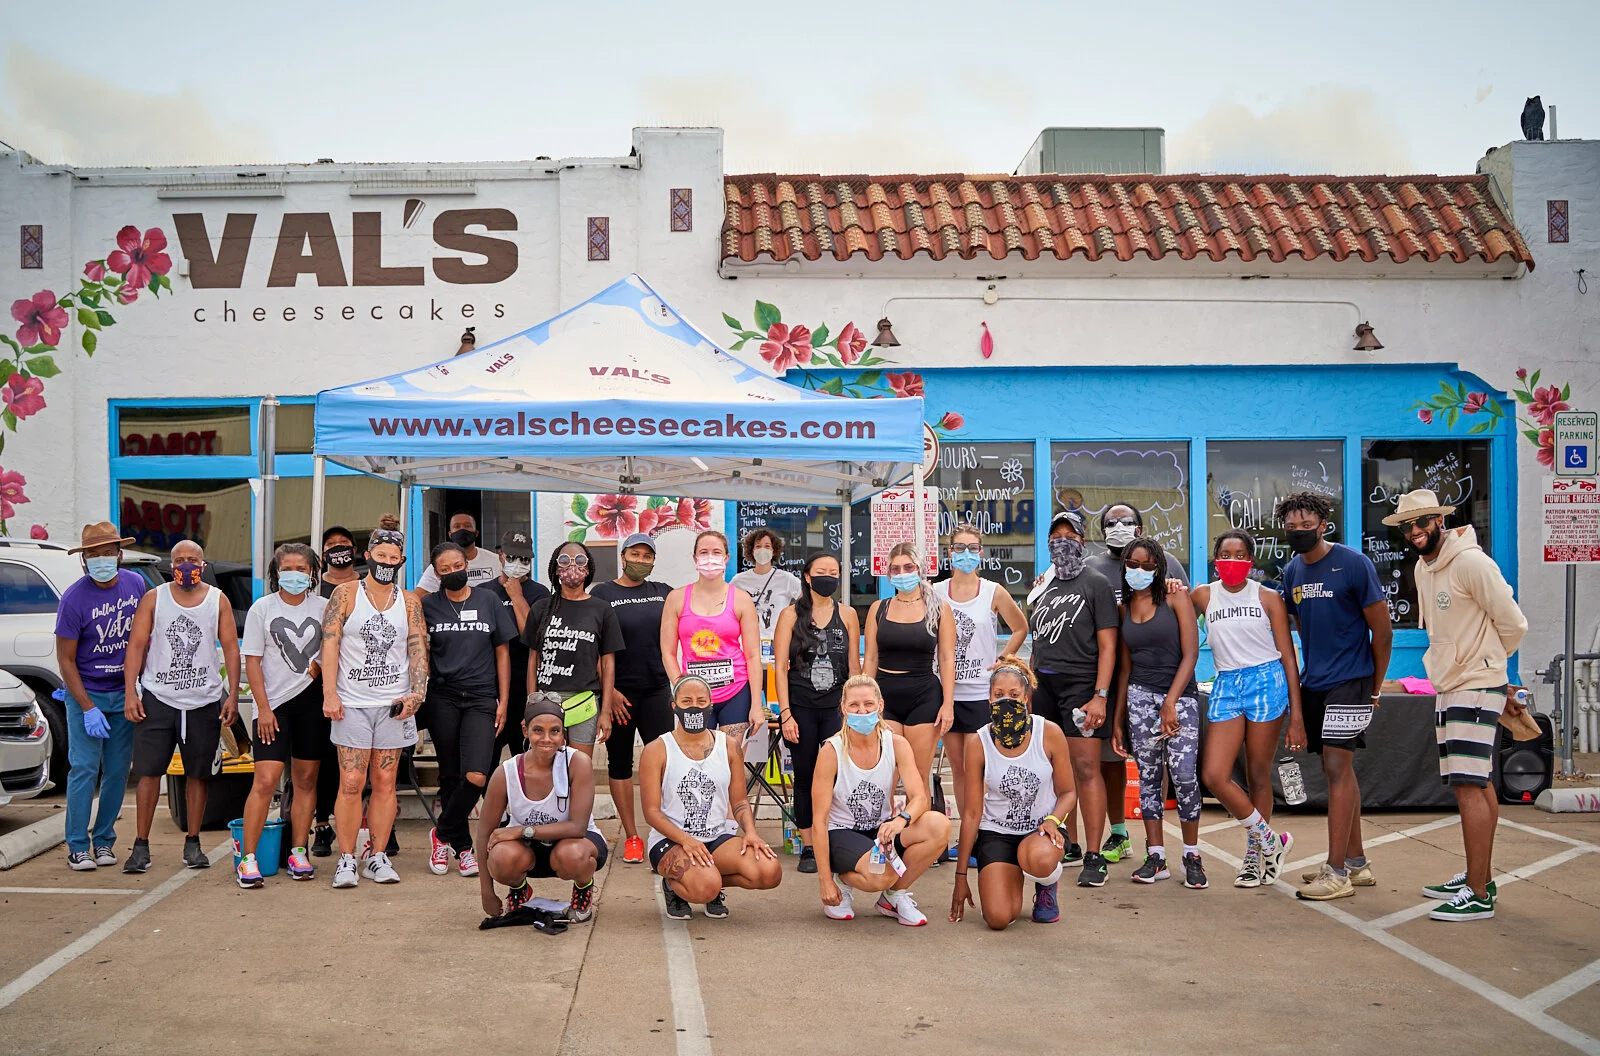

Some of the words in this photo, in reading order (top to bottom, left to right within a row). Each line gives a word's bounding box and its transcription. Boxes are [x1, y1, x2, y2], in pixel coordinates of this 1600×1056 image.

[172, 198, 519, 289] VAL'S
[194, 299, 505, 323] cheesecakes
[485, 352, 515, 375] VAL'S
[588, 366, 672, 385] VAL'S
[368, 411, 877, 440] www.valscheesecakes.com
[1557, 417, 1596, 426] RESERVED
[1559, 431, 1594, 440] PARKING
[938, 447, 978, 470] HOURS
[1424, 459, 1446, 478] HOME
[1545, 494, 1571, 503] TOWING
[1572, 494, 1600, 503] ENFORCE
[1229, 496, 1264, 530] CALL
[740, 517, 767, 527] Turtle
[977, 558, 1002, 571] IMES
[92, 602, 116, 619] Dallas
[117, 594, 139, 609] County
[610, 598, 632, 608] DALLAS
[1210, 607, 1262, 624] UNLIMITED
[429, 622, 491, 633] #REALTOR
[545, 625, 596, 643] lackness
[368, 673, 401, 688] JUSTICE
[955, 668, 981, 681] USTICE
[174, 676, 208, 691] JUSTICE
[1325, 714, 1370, 722] JUSTICE
